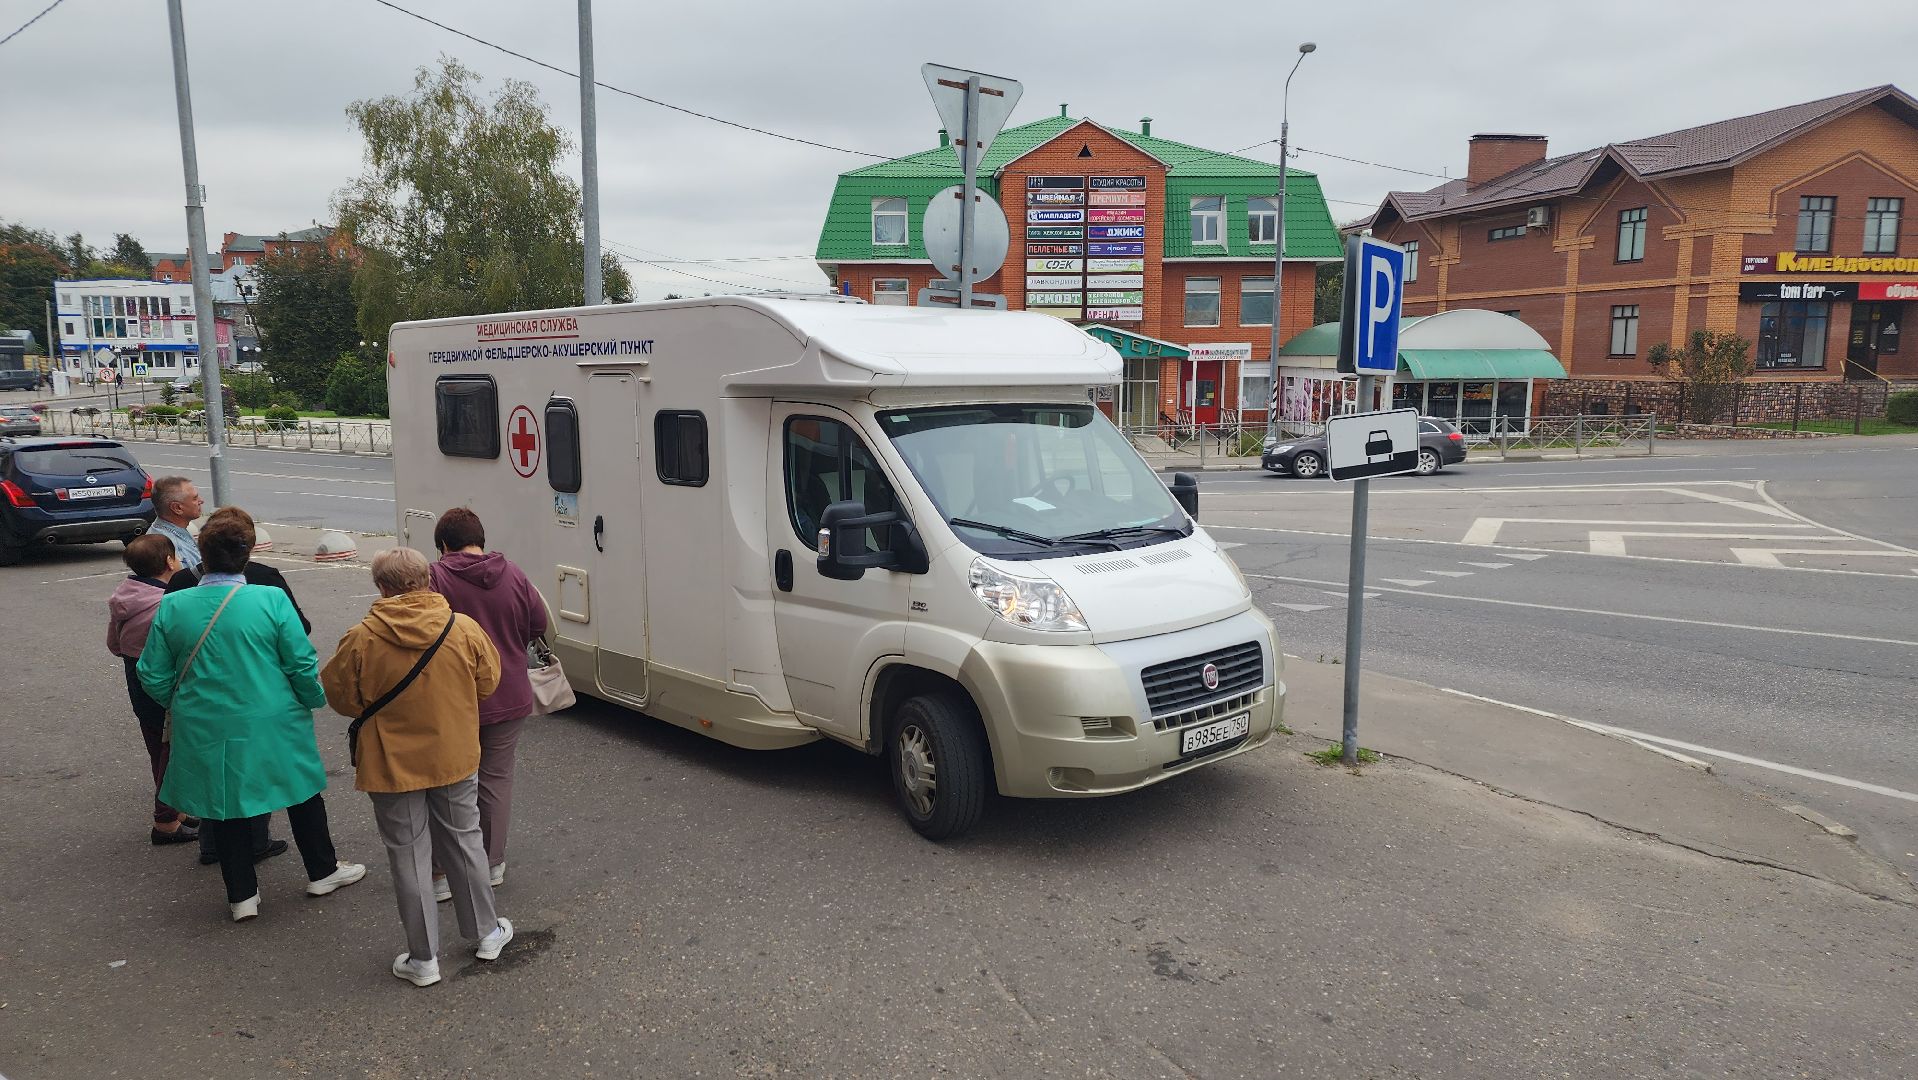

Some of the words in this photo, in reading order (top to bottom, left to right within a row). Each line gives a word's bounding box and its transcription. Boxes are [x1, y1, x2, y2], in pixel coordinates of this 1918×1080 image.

[1092, 178, 1115, 187] СТУДИЯ
[1115, 178, 1143, 187] КРАСОТЫ
[1036, 193, 1076, 201] ШВЕЙНАЯ
[1091, 194, 1129, 203] ПРЕМИУМ
[1038, 212, 1080, 220] ИМПЛАДЕНТ
[1106, 227, 1142, 237] ДЖИНС
[1028, 245, 1069, 254] ПЕЛЛЕТНЫЕ
[1045, 260, 1075, 270] CDEK
[1780, 283, 1800, 298] tom
[1803, 283, 1826, 298] farr
[1028, 293, 1081, 304] РЕМОНТ
[1087, 310, 1119, 320] АРЕНДА
[477, 320, 538, 337] МЕДИЦИНСКАЯ
[540, 317, 578, 332] СЛУЖБА
[428, 346, 483, 364] ПЕРЕДВИЖНОЙ
[485, 338, 617, 361] ФЕЛЬДШЕРСКО-АКУШЕРСКИЙ
[620, 340, 654, 355] ПУНКТ
